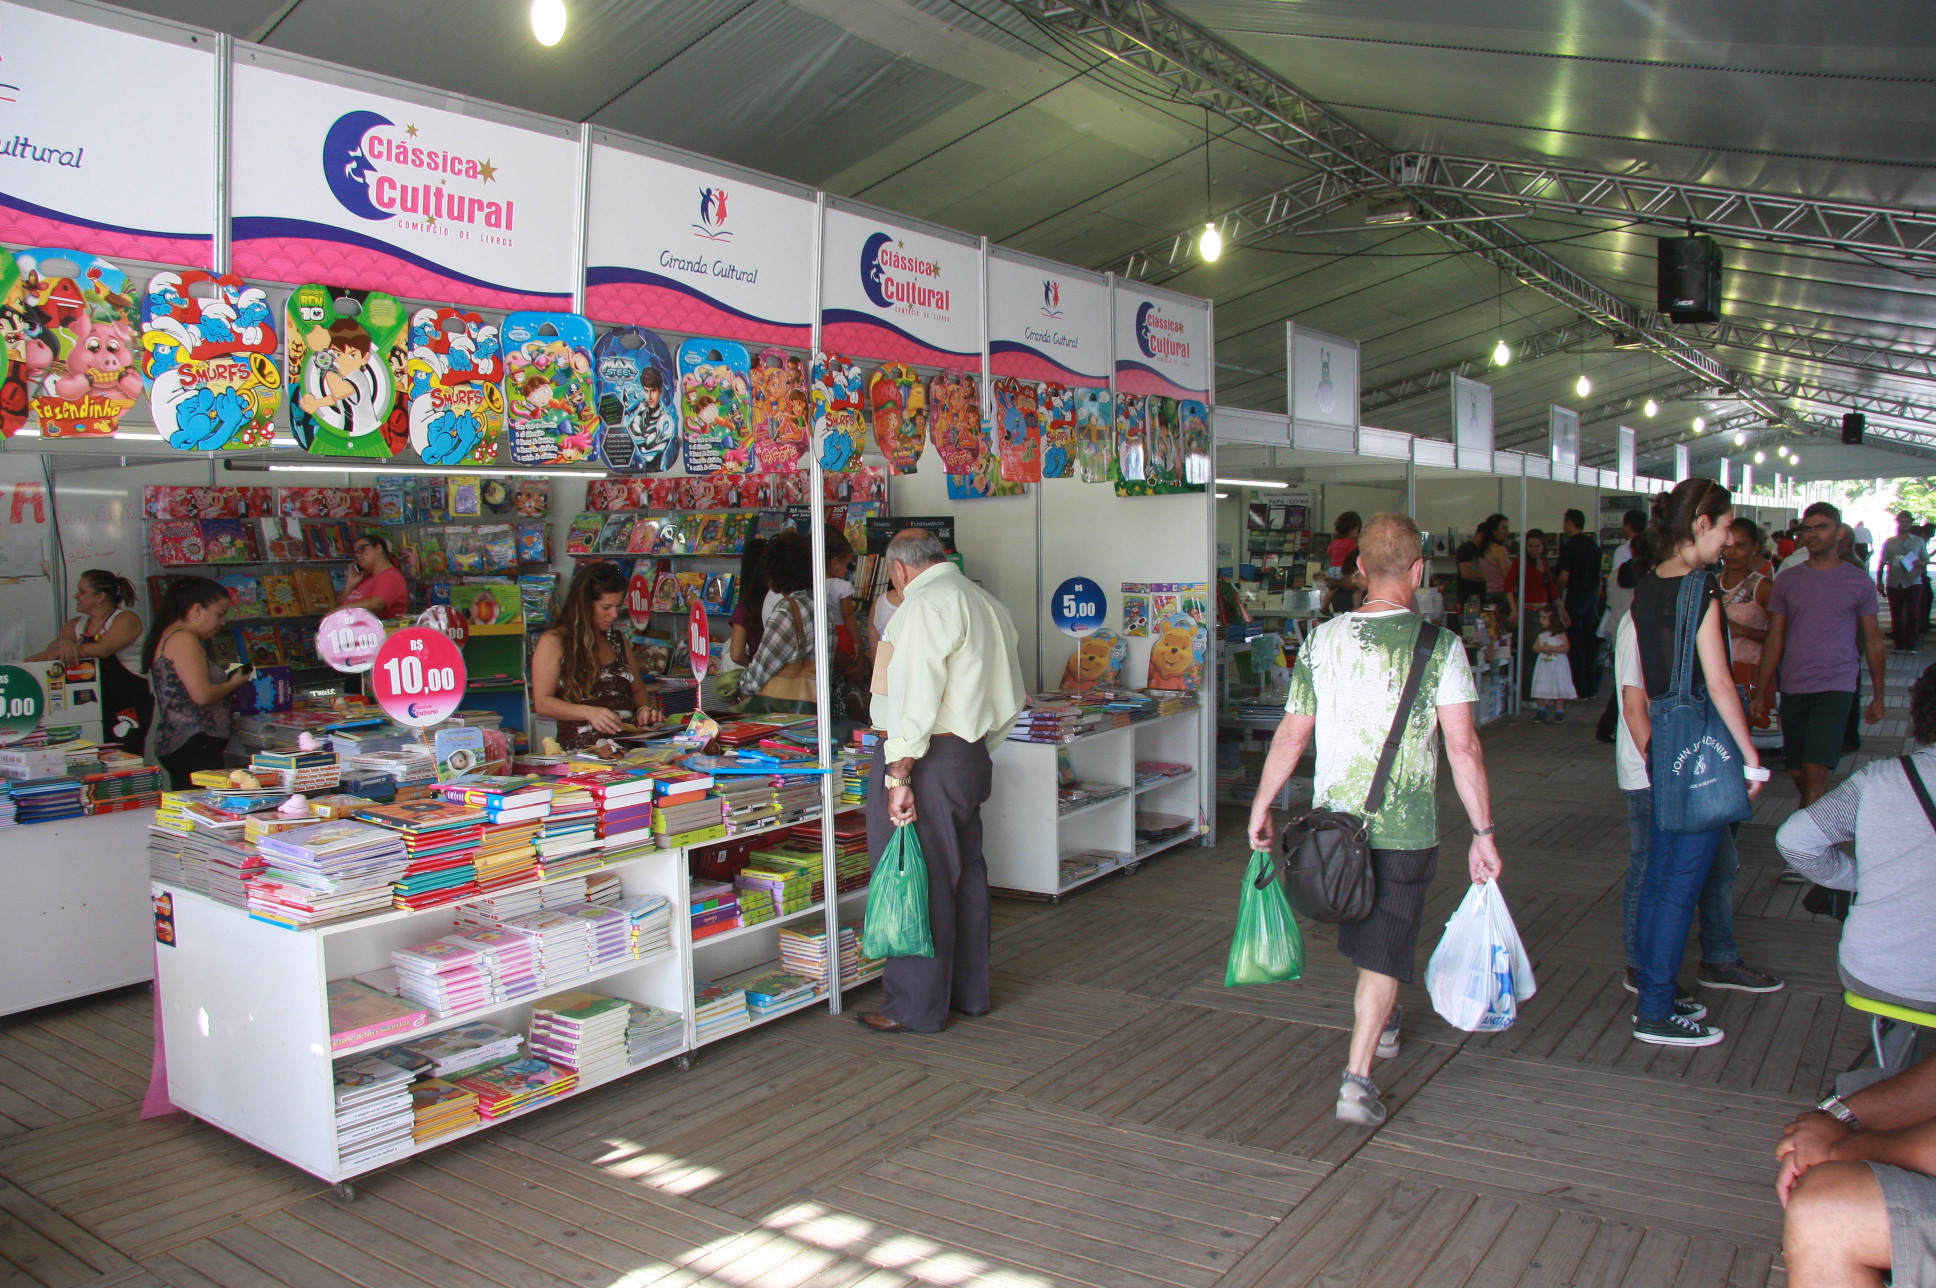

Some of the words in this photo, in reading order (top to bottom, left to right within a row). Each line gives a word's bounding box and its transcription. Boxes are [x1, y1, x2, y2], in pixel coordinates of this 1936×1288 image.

[0, 135, 84, 168] ultural
[368, 135, 479, 179] Clássica
[375, 176, 514, 232] Cultural
[460, 230, 470, 240] DE
[480, 234, 513, 247] LIVROS
[660, 250, 708, 275] Ciranda
[712, 260, 758, 283] Cultural
[881, 249, 932, 276] Clássica
[884, 277, 950, 311] Cultural
[1147, 314, 1179, 333] Clássica
[1024, 327, 1051, 344] Ciranda
[1052, 332, 1079, 349] Cultural
[1150, 334, 1190, 359] Cultural
[177, 362, 251, 387] SMURFS
[602, 358, 635, 370] MAX
[606, 368, 636, 376] STEEL
[30, 396, 122, 419] Fazendinha
[431, 388, 484, 408] SMURFS
[825, 413, 855, 428] SMURFS
[0, 482, 45, 524] A
[1074, 584, 1083, 592] R$
[631, 590, 648, 612] 10,00
[1063, 594, 1096, 618] 5,00
[344, 617, 354, 625] R$
[327, 627, 378, 654] 10,00
[410, 638, 424, 651] R$
[66, 668, 95, 676] MasterCard
[384, 655, 455, 695] 10,00
[1671, 747, 1692, 776] JOHN
[1705, 735, 1730, 762] DENIM
